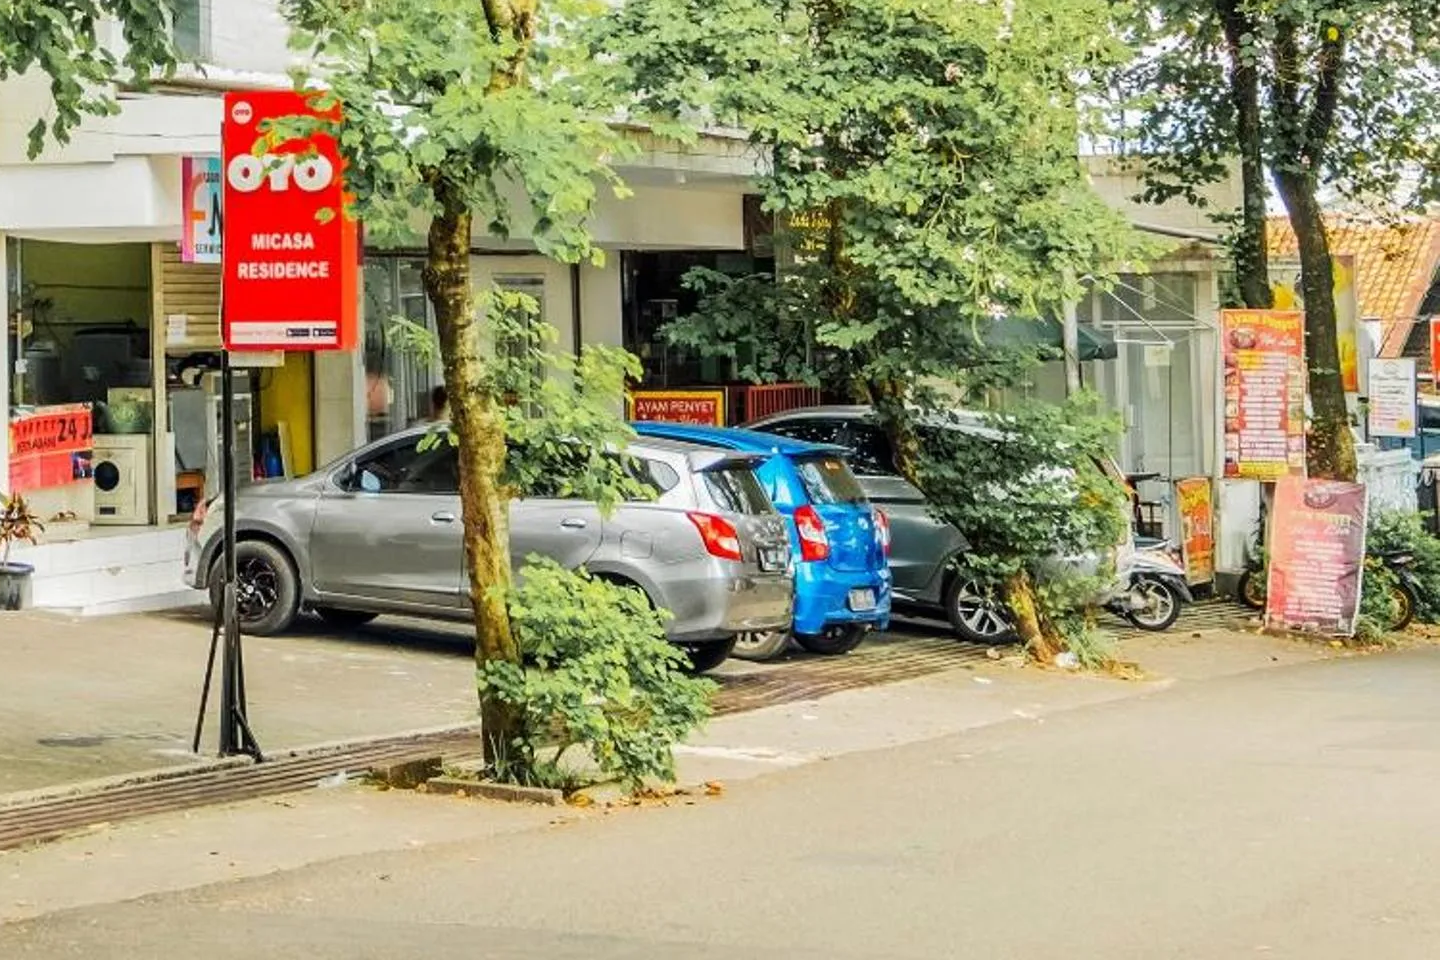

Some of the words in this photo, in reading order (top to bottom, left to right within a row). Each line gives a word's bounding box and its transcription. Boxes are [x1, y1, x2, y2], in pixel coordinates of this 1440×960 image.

[228, 153, 334, 192] OYO
[252, 233, 314, 250] MICASA
[238, 261, 329, 279] RESIDENCE
[637, 400, 669, 414] AYAM
[670, 400, 715, 413] PENYET
[58, 418, 78, 442] 24
